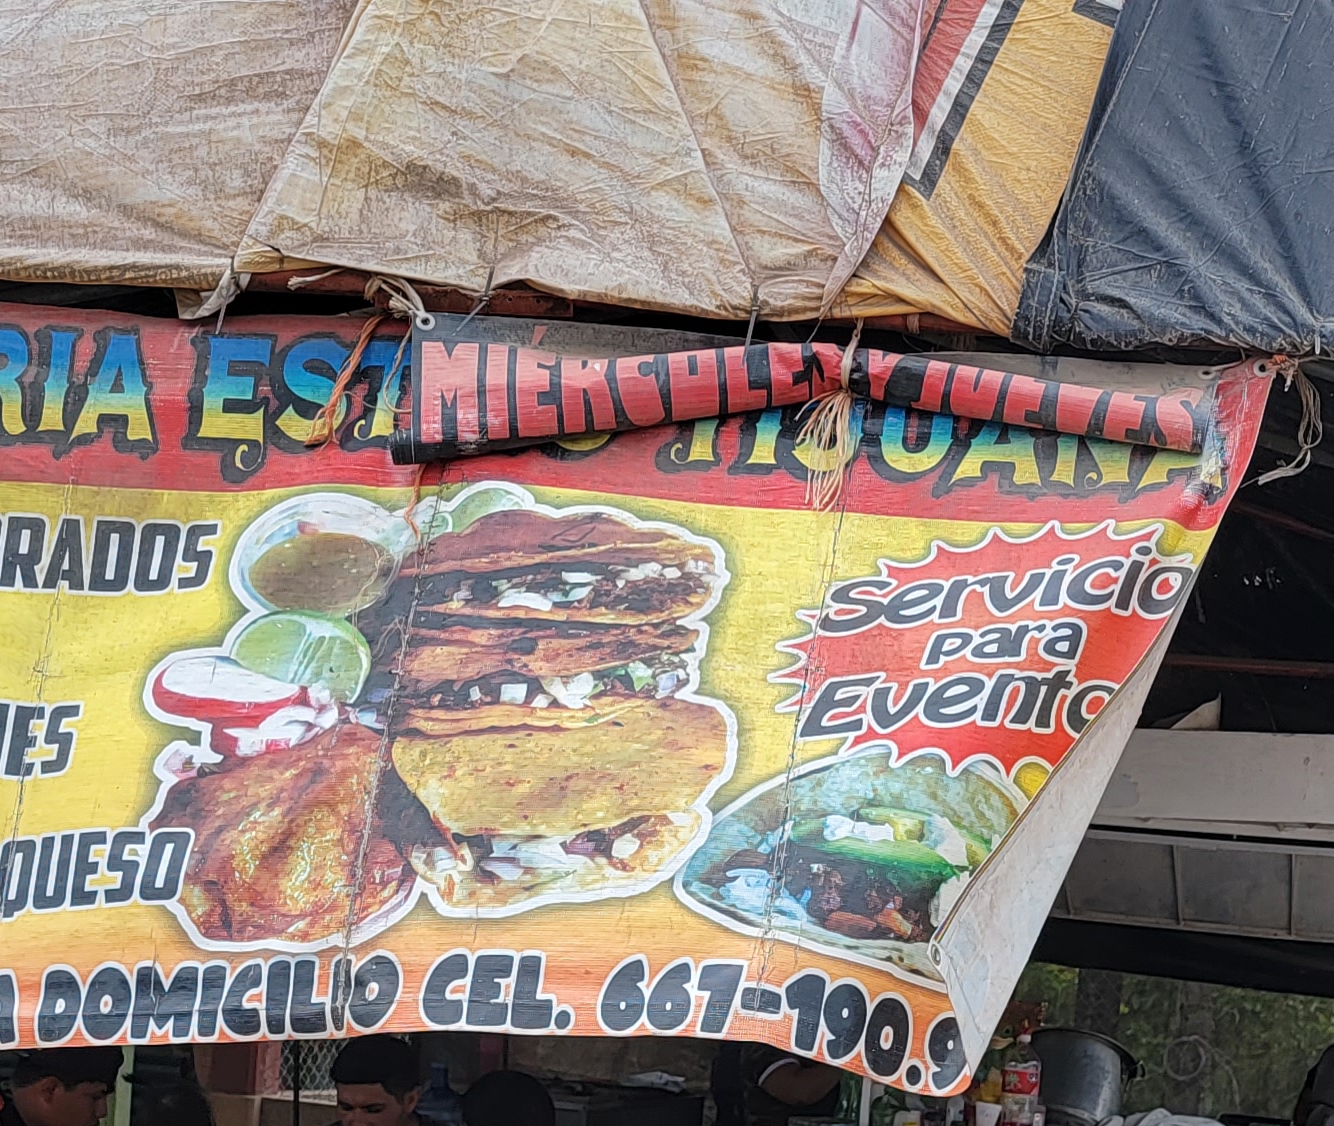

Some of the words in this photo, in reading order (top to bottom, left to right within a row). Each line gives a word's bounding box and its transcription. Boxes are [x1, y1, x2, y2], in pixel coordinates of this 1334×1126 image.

[868, 348, 904, 401] Y
[818, 545, 1195, 632] Servicio
[923, 619, 1085, 668] para
[36, 950, 402, 1045] DOMICILIO
[420, 948, 575, 1032] CEL.
